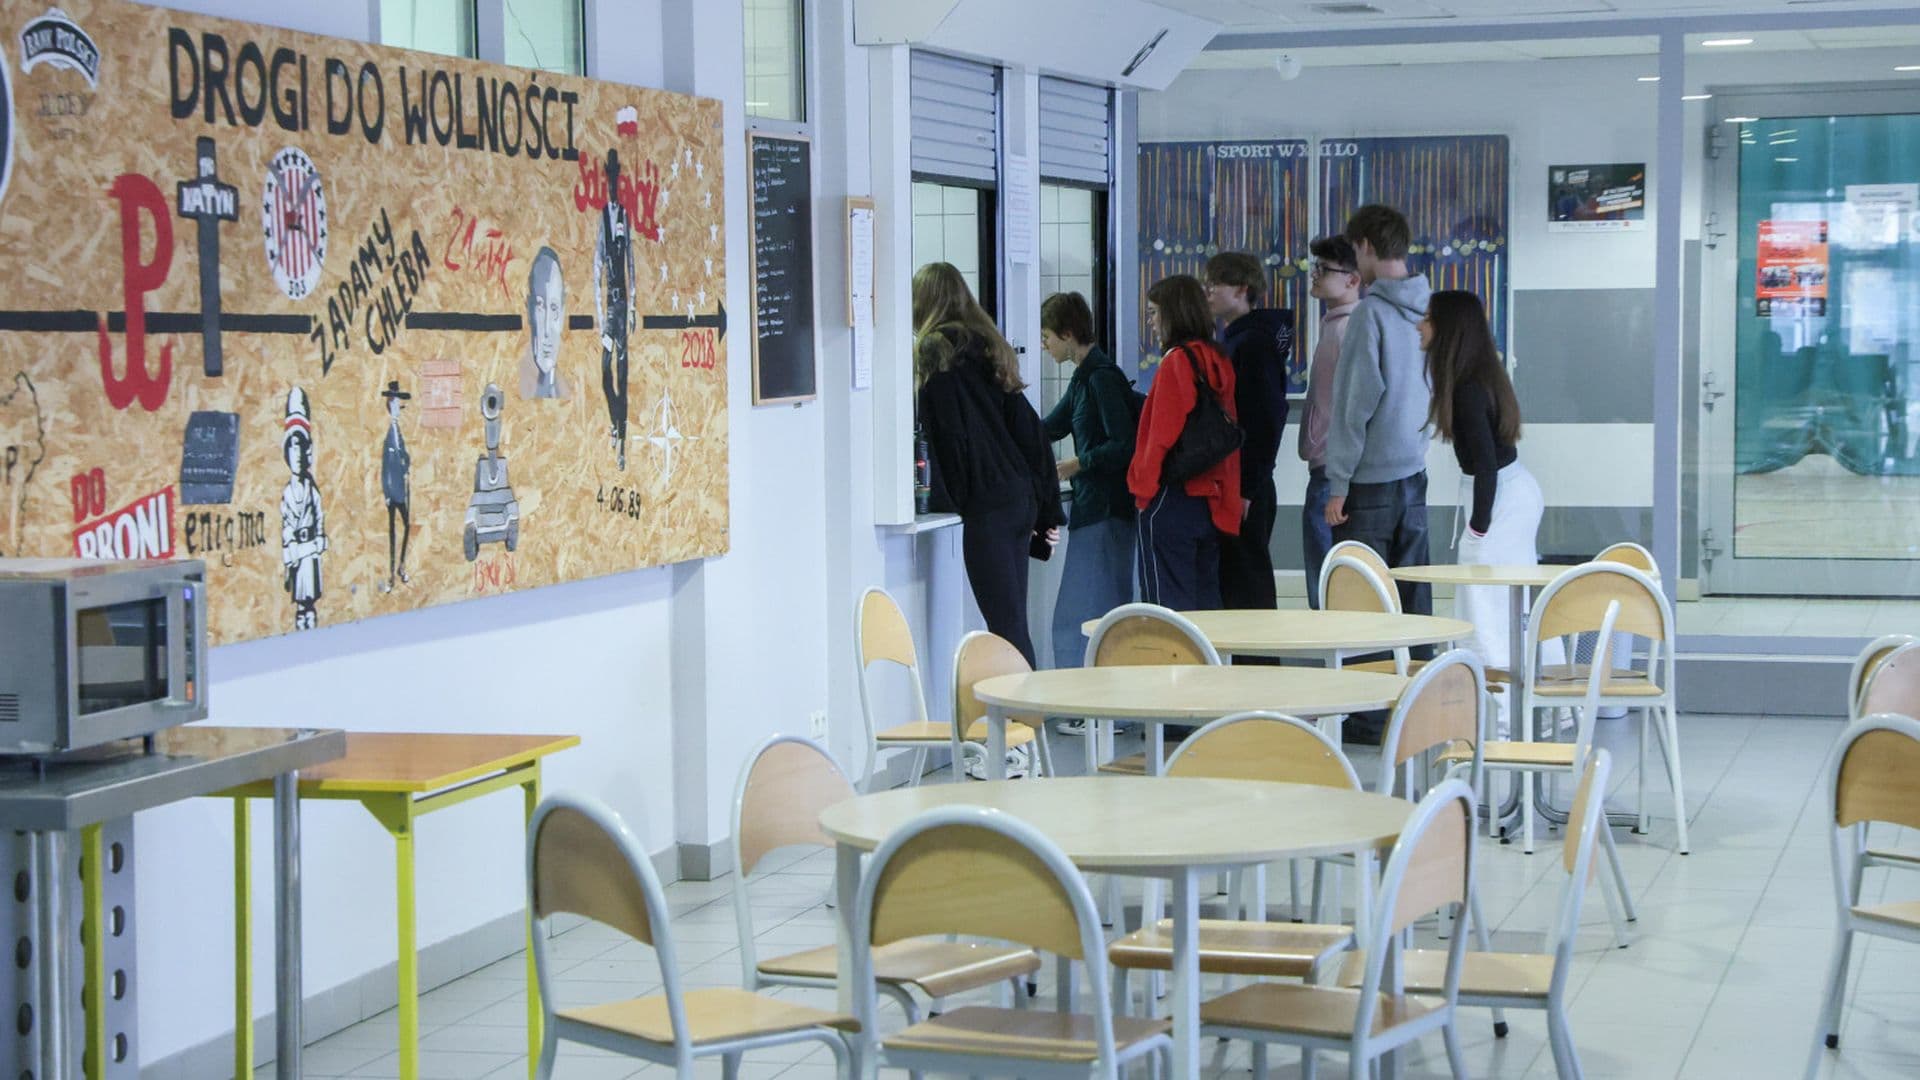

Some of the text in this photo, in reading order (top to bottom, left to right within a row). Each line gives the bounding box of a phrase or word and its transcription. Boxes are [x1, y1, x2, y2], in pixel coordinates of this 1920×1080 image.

[168, 28, 579, 161] DROGI DO WOLNOŚCI
[1217, 145, 1274, 159] SPORT
[1277, 144, 1295, 157] W
[1335, 143, 1358, 157] LO
[366, 229, 432, 355] CHLEBA
[681, 328, 716, 370] 2018
[71, 466, 107, 524] DO
